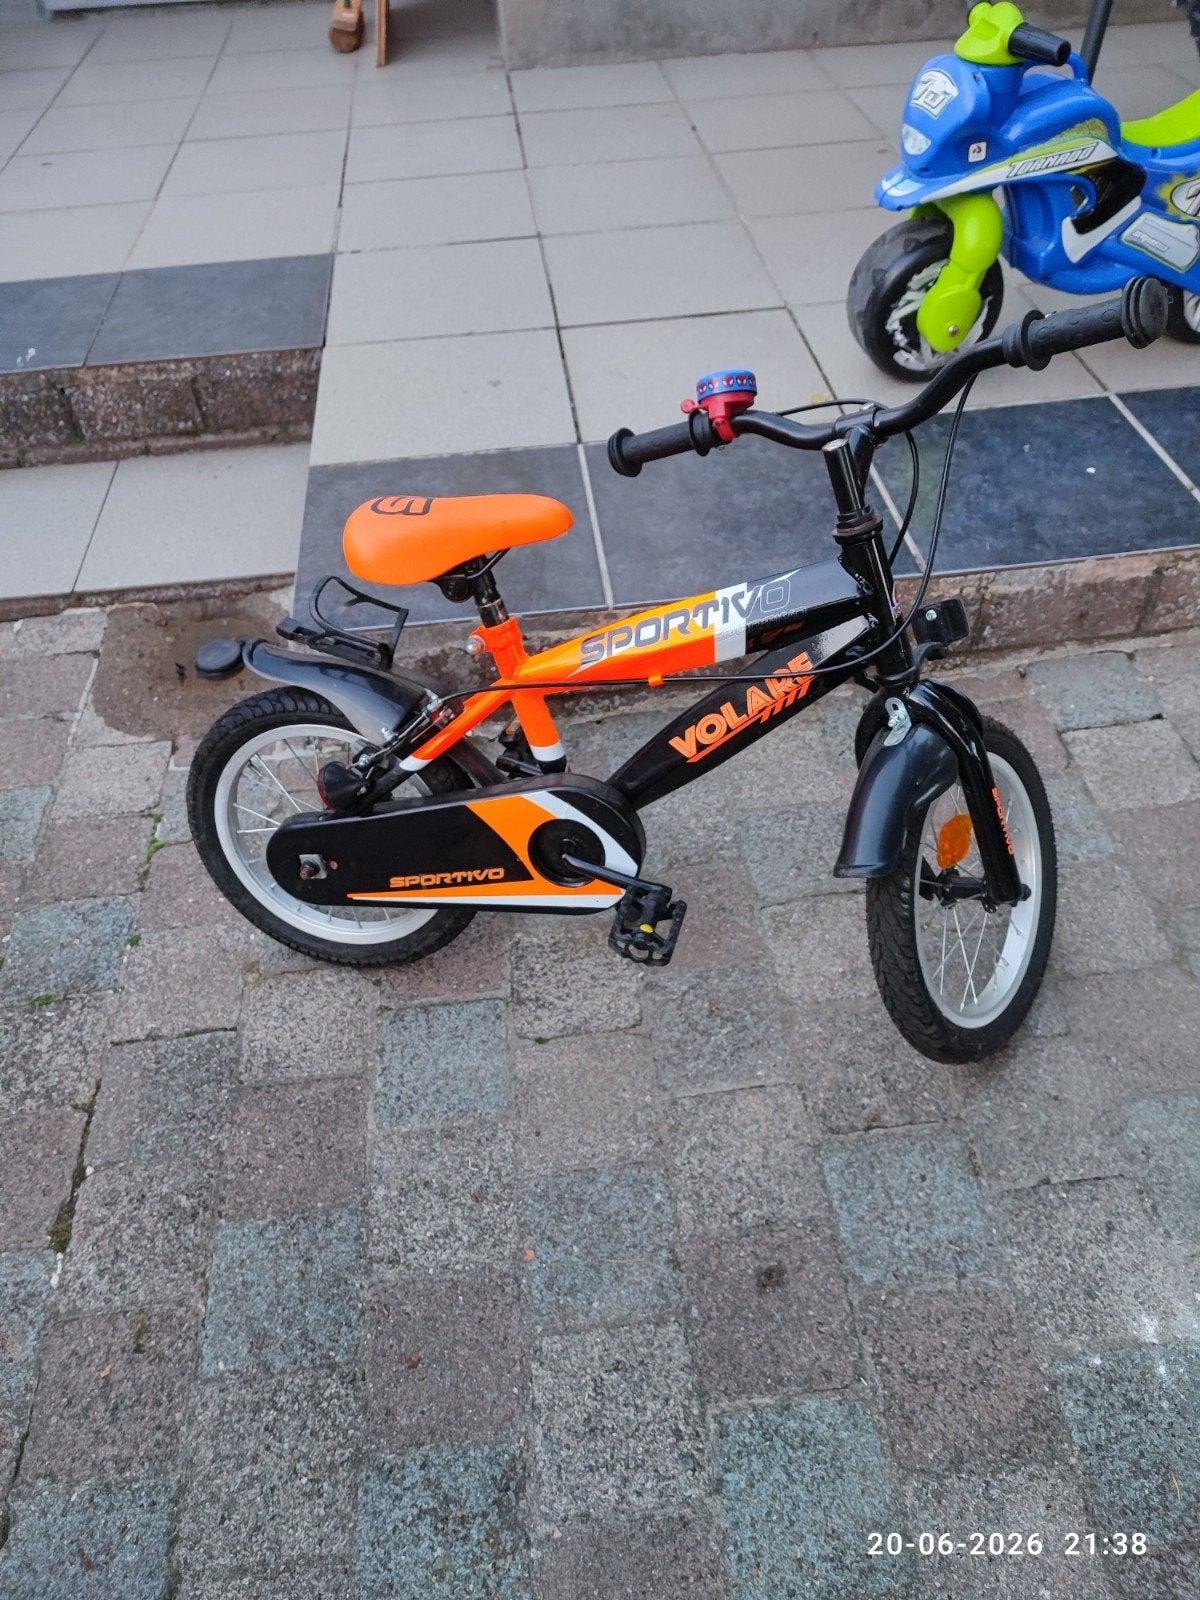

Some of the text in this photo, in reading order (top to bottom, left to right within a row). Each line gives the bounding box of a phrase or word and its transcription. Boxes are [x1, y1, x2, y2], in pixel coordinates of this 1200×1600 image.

[1006, 141, 1099, 178] TORNADO
[579, 577, 791, 665] SPORTIVO
[668, 651, 816, 759] VOLARE
[389, 867, 505, 888] SPORTIVO
